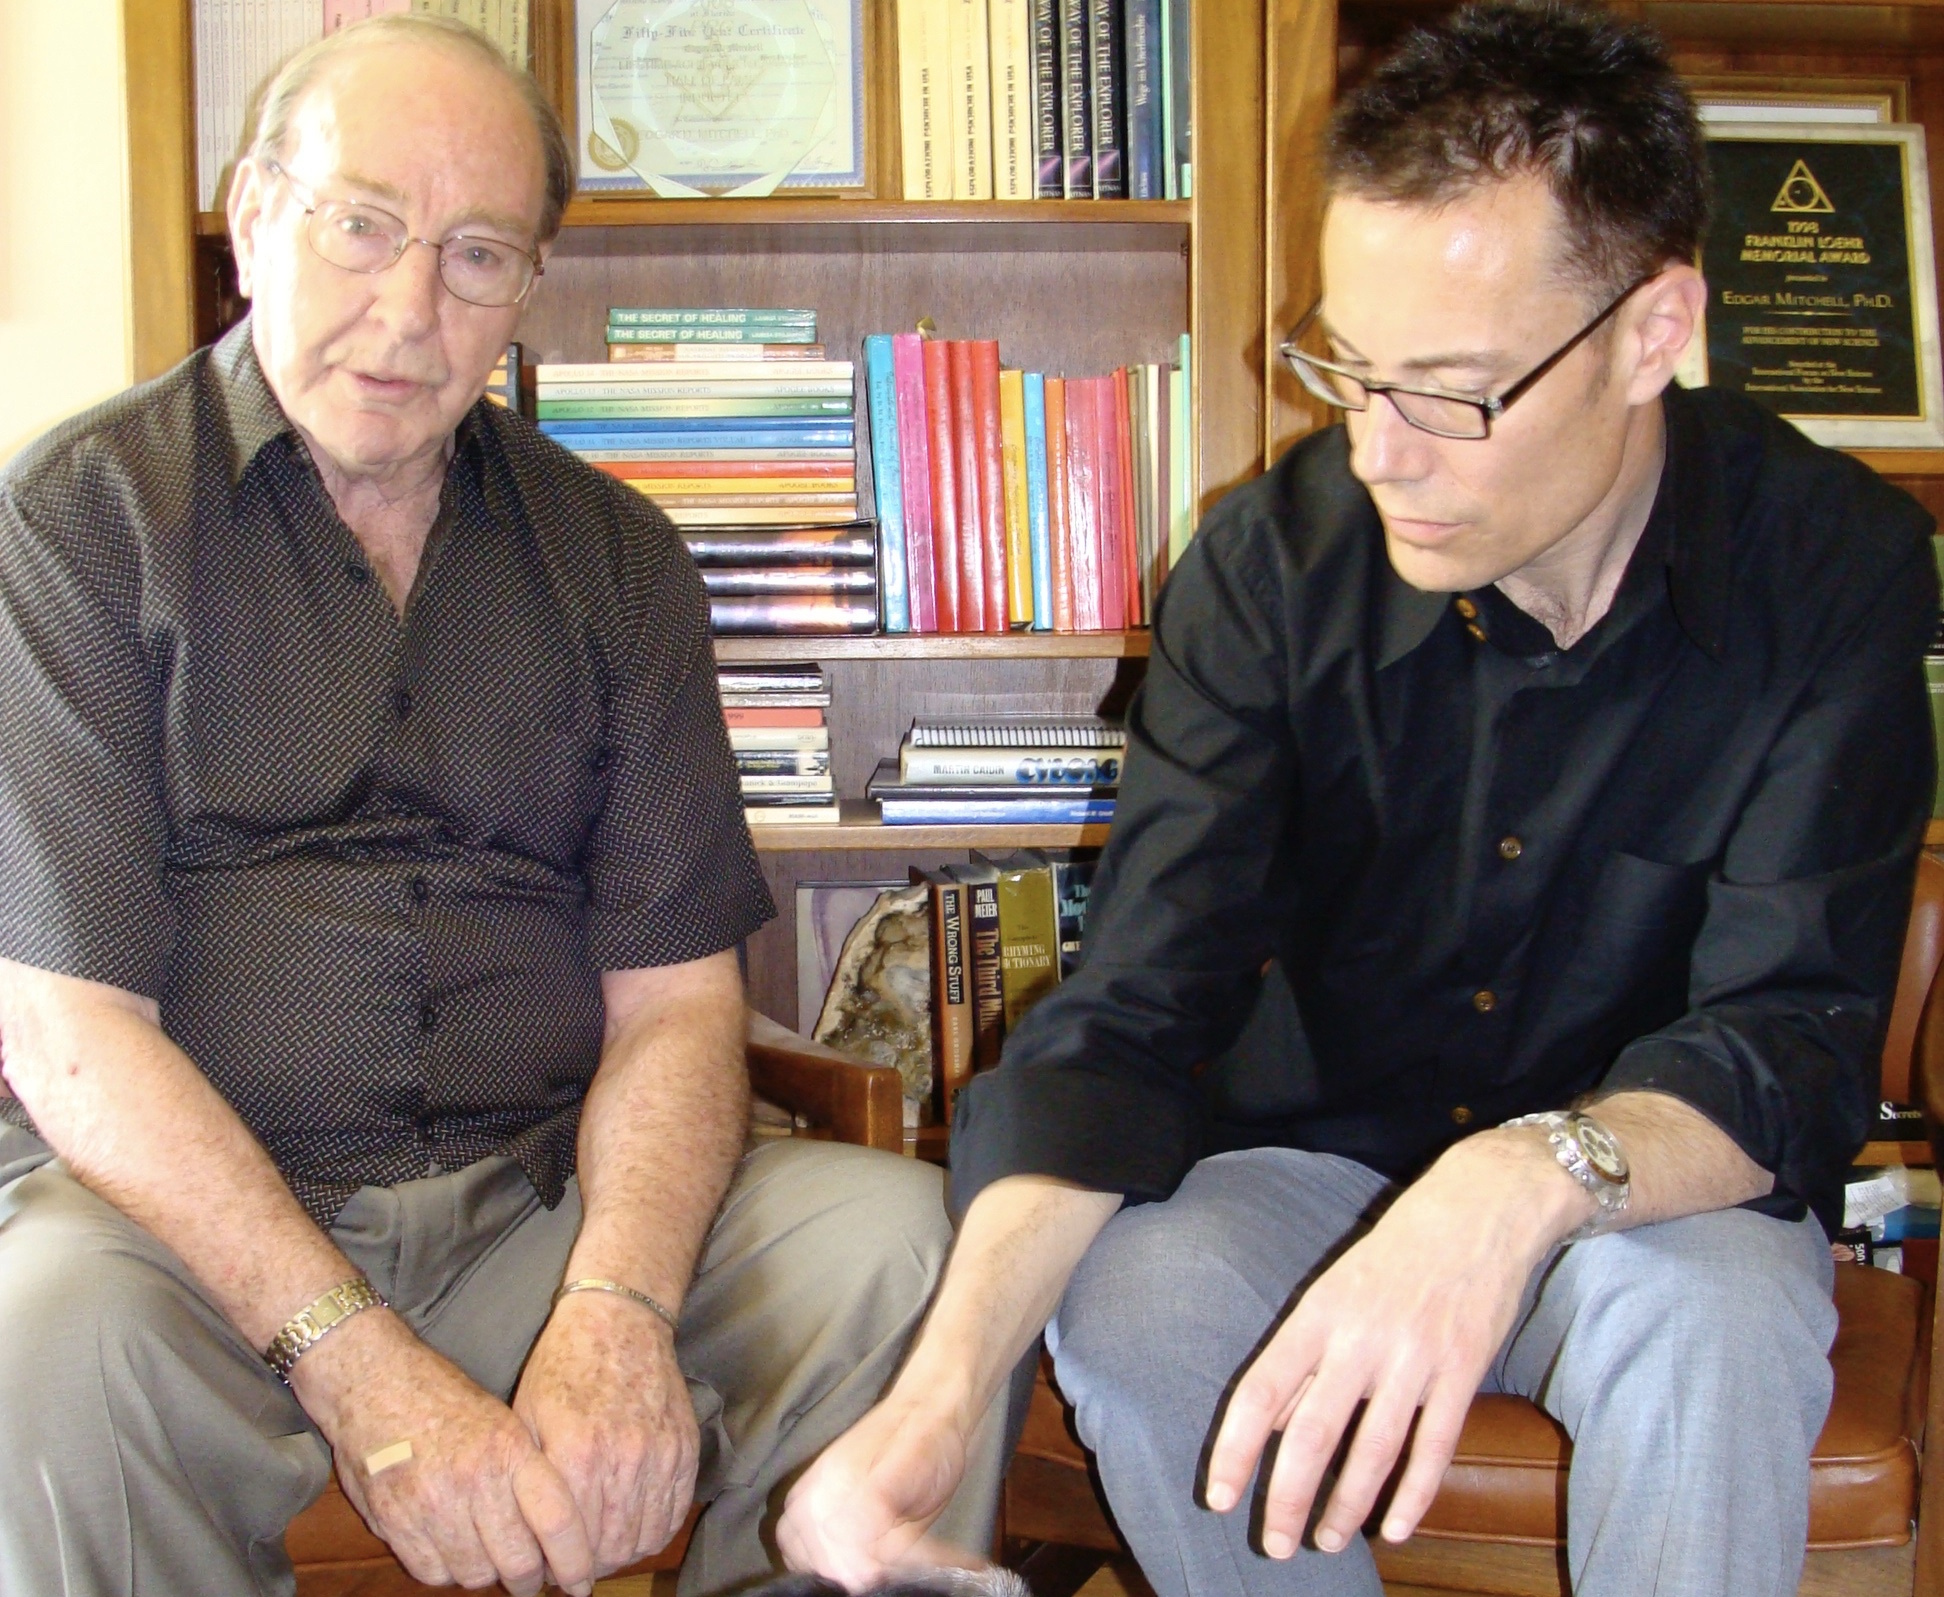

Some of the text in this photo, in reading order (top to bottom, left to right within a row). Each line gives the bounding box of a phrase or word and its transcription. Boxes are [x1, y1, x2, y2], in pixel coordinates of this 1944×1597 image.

[738, 24, 806, 36] Certificate
[1038, 26, 1052, 46] OF
[1068, 28, 1082, 47] OF
[1038, 49, 1052, 78] THE
[1068, 50, 1082, 80] THE
[1094, 0, 1114, 145] AY OF THE EXPLORER
[1038, 82, 1054, 150] EXPLORER
[1068, 82, 1084, 151] EXPLORER
[1744, 234, 1814, 248] FRANKLIN
[1740, 249, 1871, 264] MEMORIAL AWARD
[618, 314, 638, 323] THE
[641, 314, 680, 323] SECRET
[684, 314, 698, 323] OF
[702, 314, 746, 323] HEALING
[614, 330, 634, 340] THE
[638, 330, 677, 340] SECRET
[680, 330, 694, 340] OF
[696, 330, 742, 340] HEALING
[618, 406, 638, 414] NASA
[643, 437, 676, 445] MISSION
[677, 437, 712, 445] REPORTS
[934, 764, 1004, 776] MARTIN CAIDIN
[1016, 757, 1118, 784] CYBORG
[976, 888, 994, 903] PAUL
[975, 903, 998, 918] MEIER
[945, 894, 963, 1004] THE WRONG STUFF
[976, 928, 1000, 955] The
[1003, 944, 1045, 957] RHYMING
[976, 956, 1002, 996] Third
